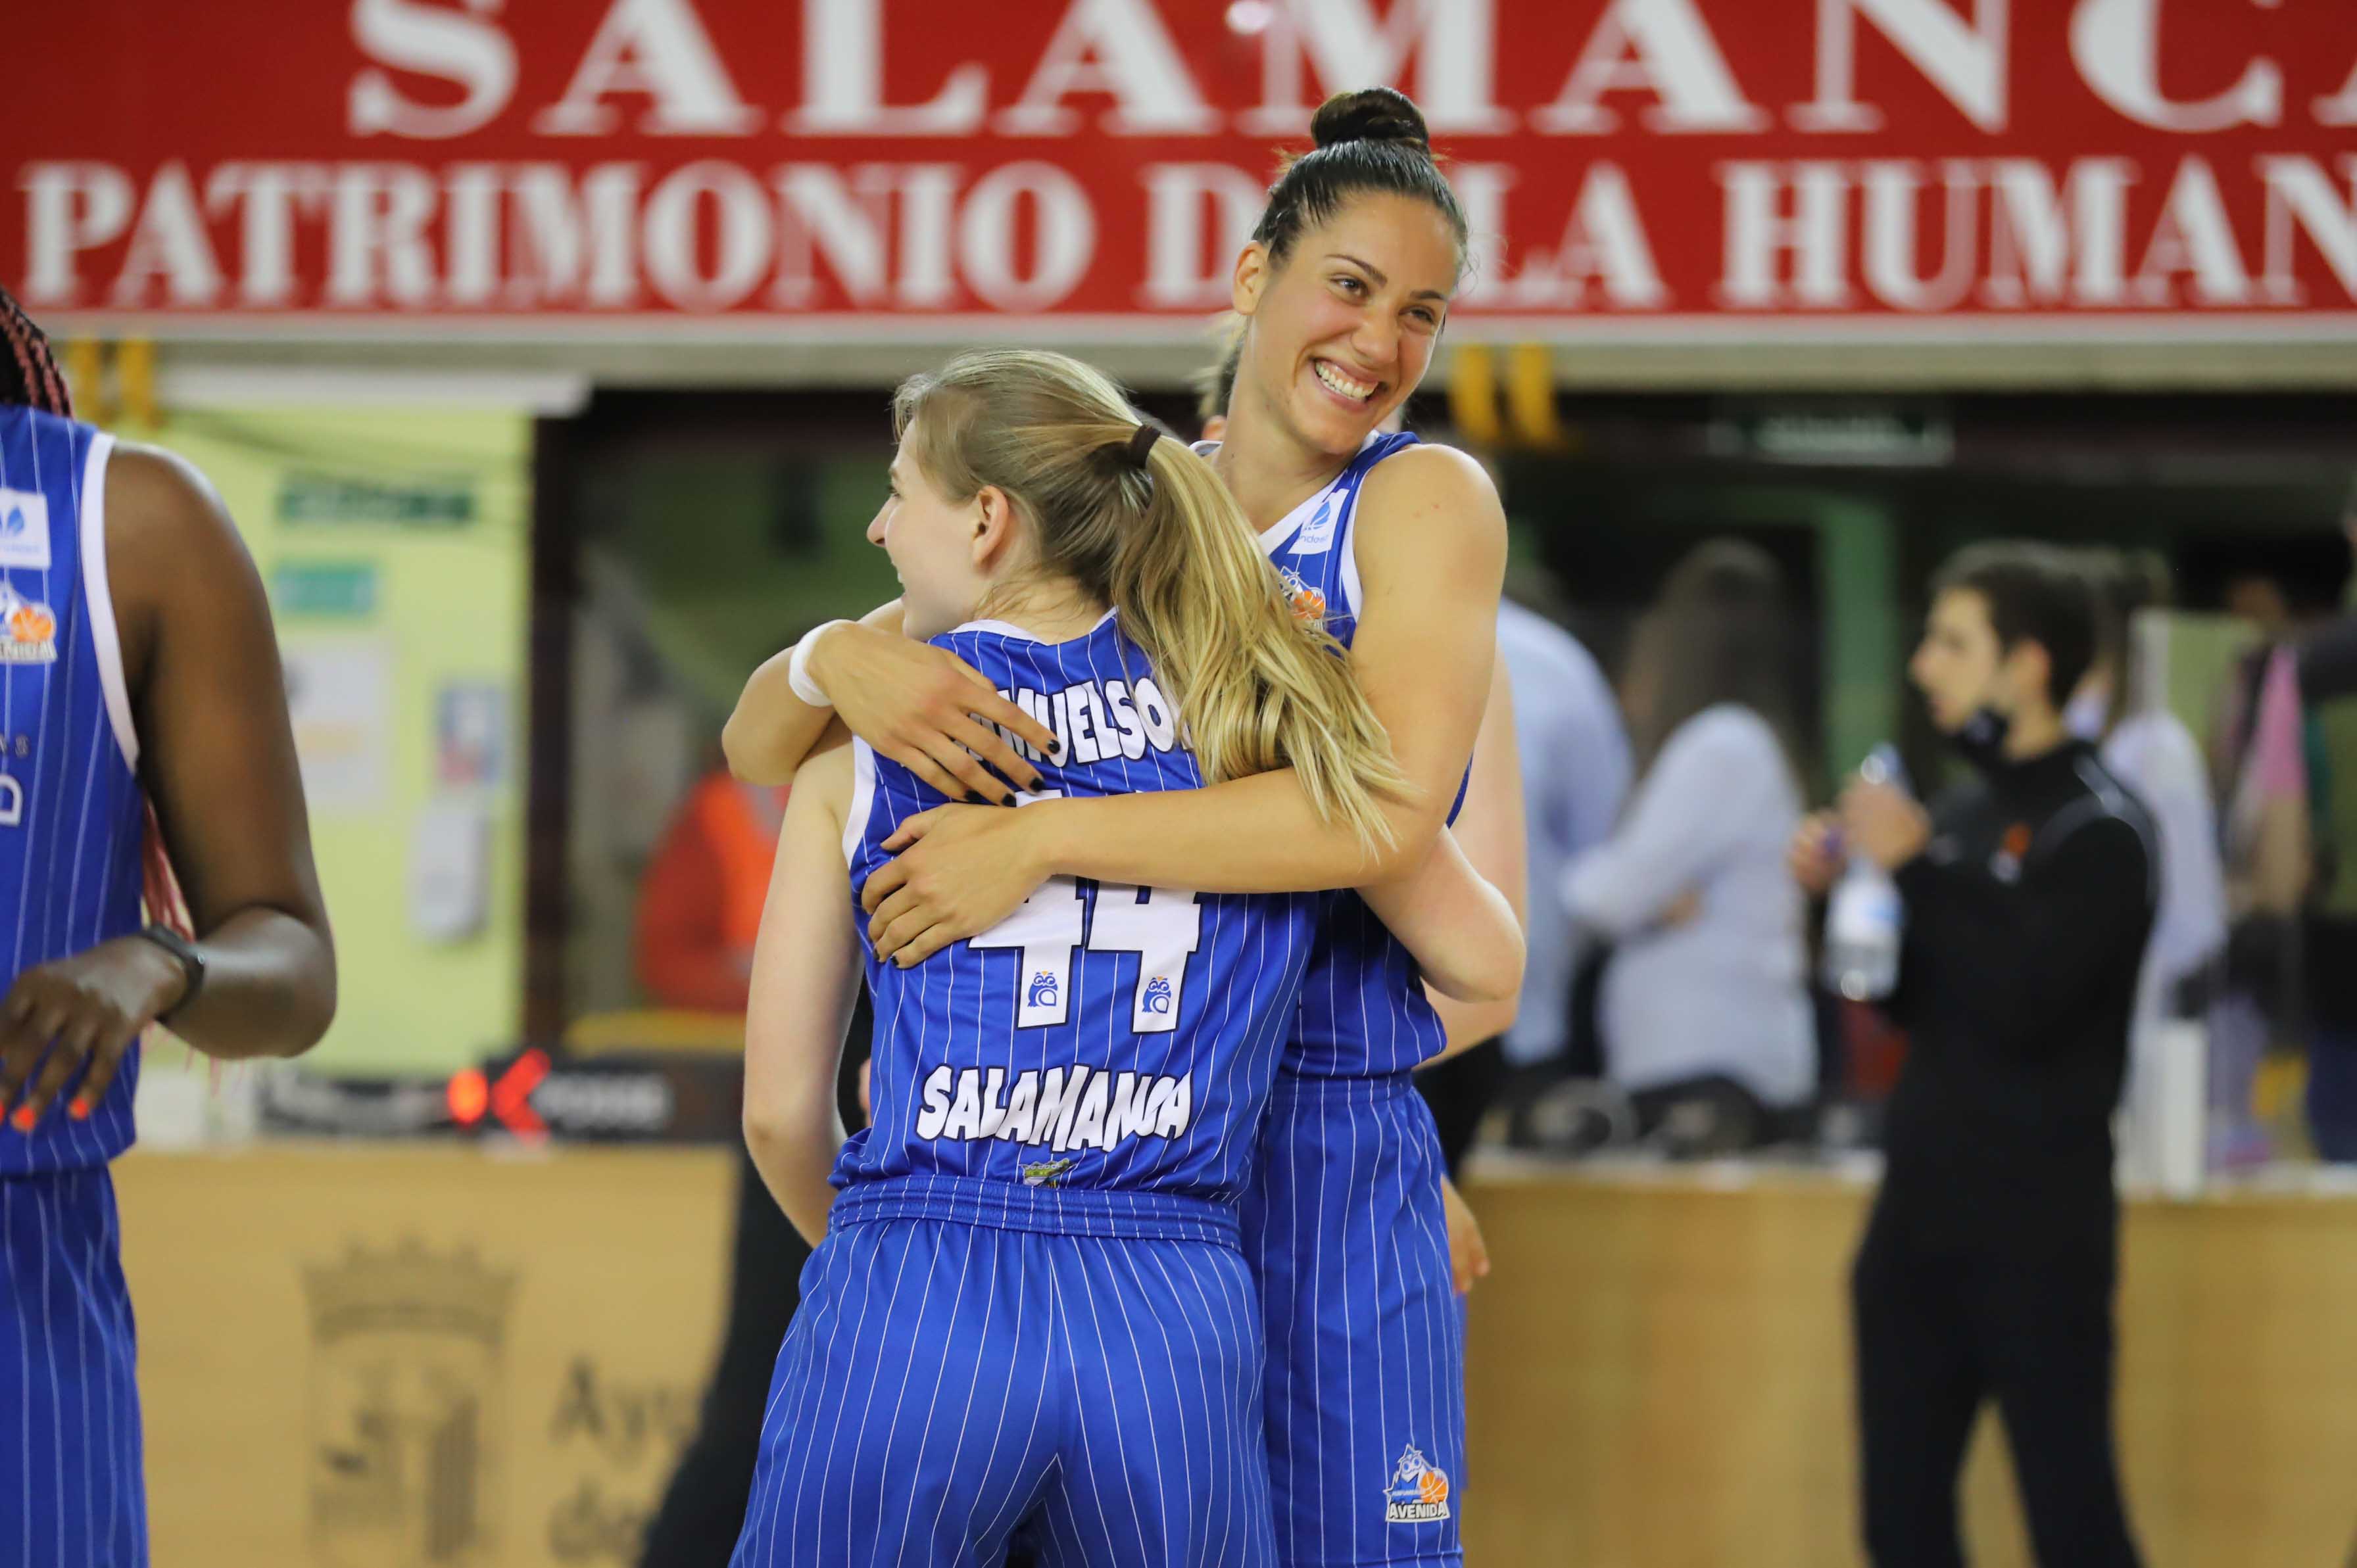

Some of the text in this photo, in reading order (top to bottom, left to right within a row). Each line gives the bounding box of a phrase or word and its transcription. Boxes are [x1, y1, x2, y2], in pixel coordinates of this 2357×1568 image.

[347, 0, 2357, 137] SALAMANC
[16, 158, 1100, 312] PATRIMONIO
[1132, 160, 1266, 309] D
[1447, 160, 1674, 309] LA
[915, 1063, 1196, 1153] SALAMANCA
[1388, 1500, 1448, 1520] AVENIDA
